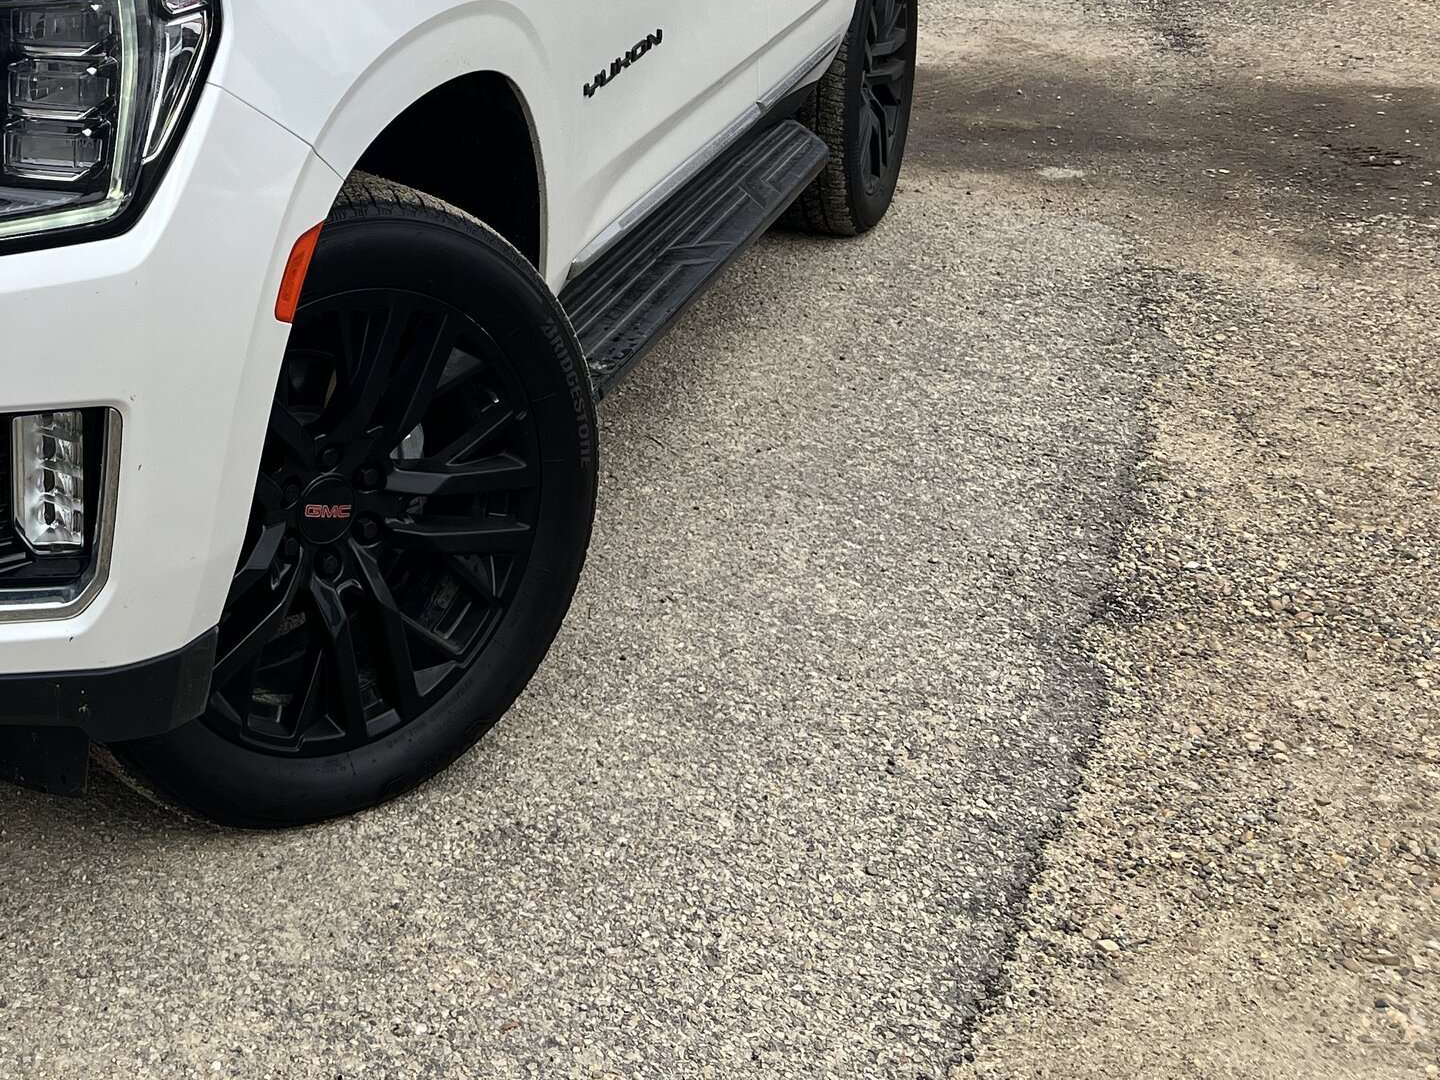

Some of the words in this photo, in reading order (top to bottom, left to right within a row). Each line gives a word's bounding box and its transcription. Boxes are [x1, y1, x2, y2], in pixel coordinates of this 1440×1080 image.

[582, 28, 663, 99] YUKON
[541, 317, 593, 468] BRIDGESTONE
[305, 504, 351, 518] GMC
